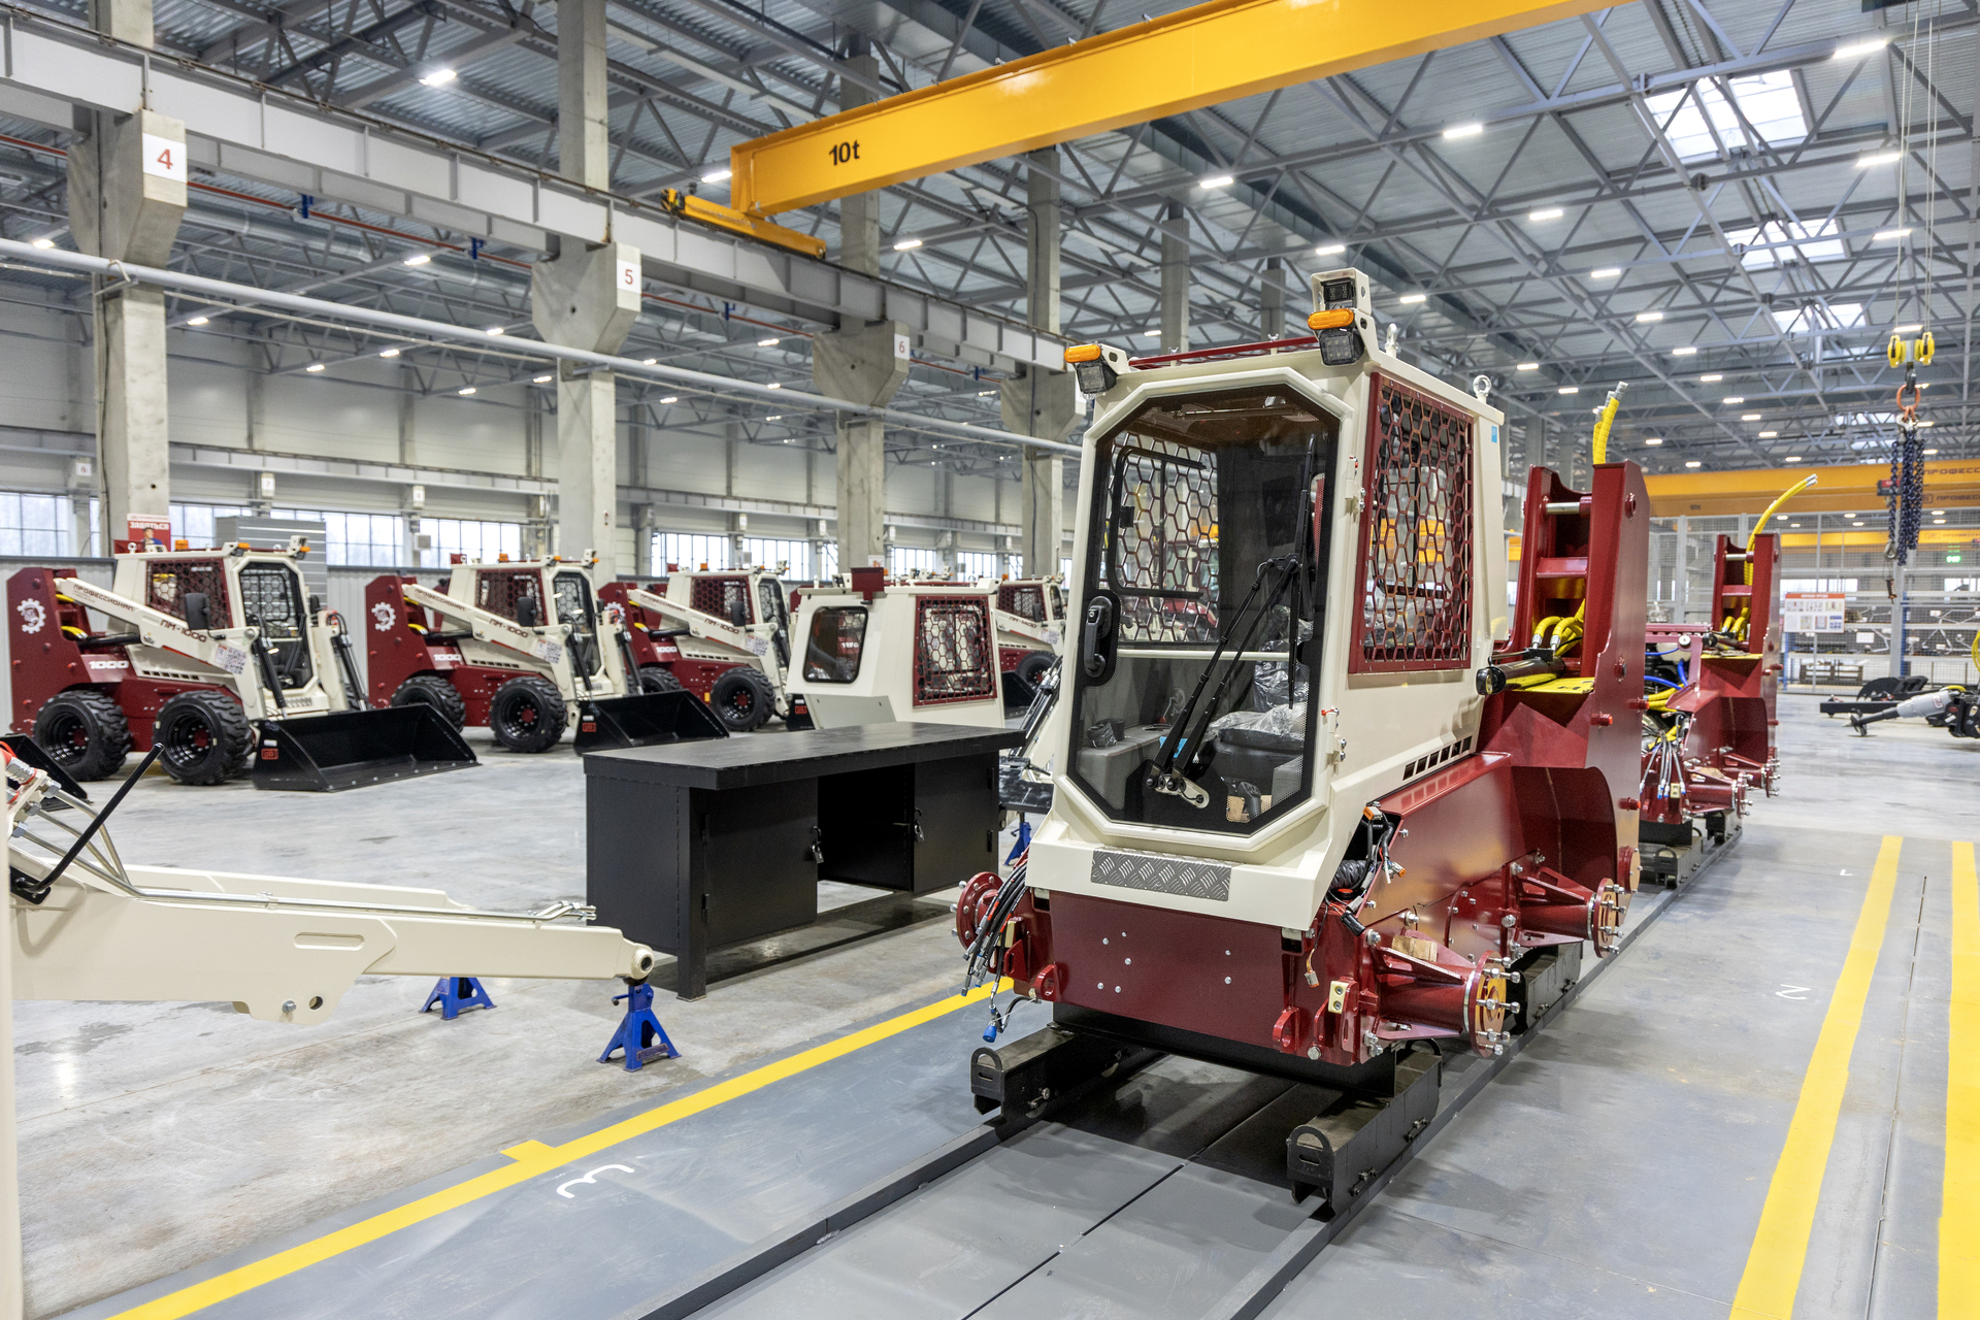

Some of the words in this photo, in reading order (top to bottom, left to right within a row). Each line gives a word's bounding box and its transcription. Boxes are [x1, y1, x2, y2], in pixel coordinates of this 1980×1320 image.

[157, 149, 173, 170] 4
[625, 268, 633, 286] 5
[899, 340, 906, 354] 6
[73, 584, 135, 612] ПРОФЕССИОНАЛ
[160, 619, 207, 643] ПМ-1000
[489, 618, 529, 638] ПМ-1000
[89, 660, 129, 670] 1000
[433, 653, 462, 661] 1000
